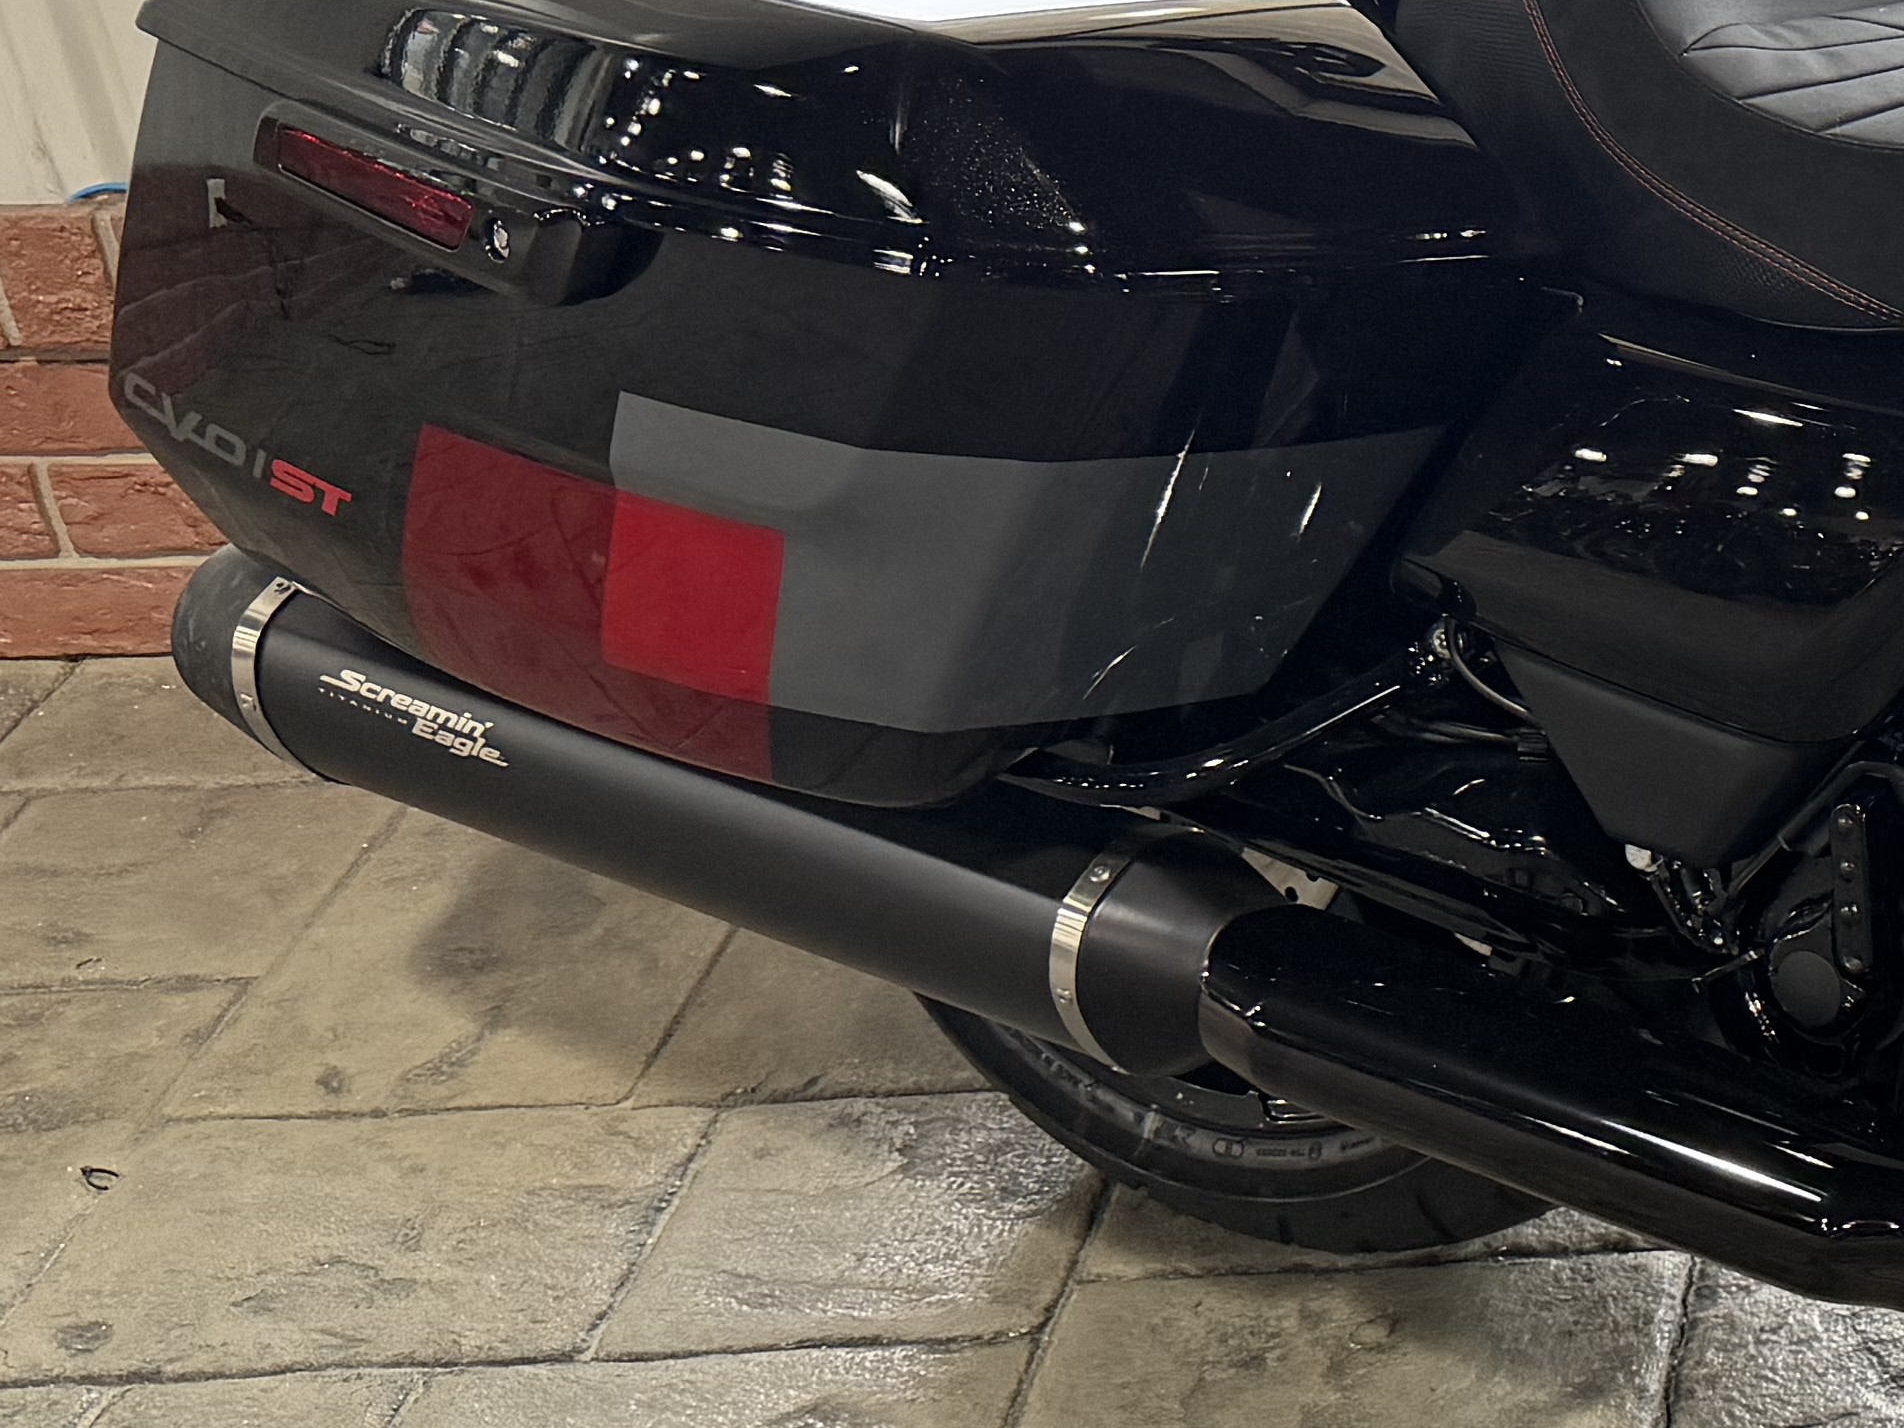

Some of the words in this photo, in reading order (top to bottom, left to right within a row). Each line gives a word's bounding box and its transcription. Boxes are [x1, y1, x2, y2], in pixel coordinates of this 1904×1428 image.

[123, 371, 247, 468] CVO
[270, 458, 352, 517] ST
[319, 669, 495, 738] Screamin'
[411, 717, 509, 768] Eagle
